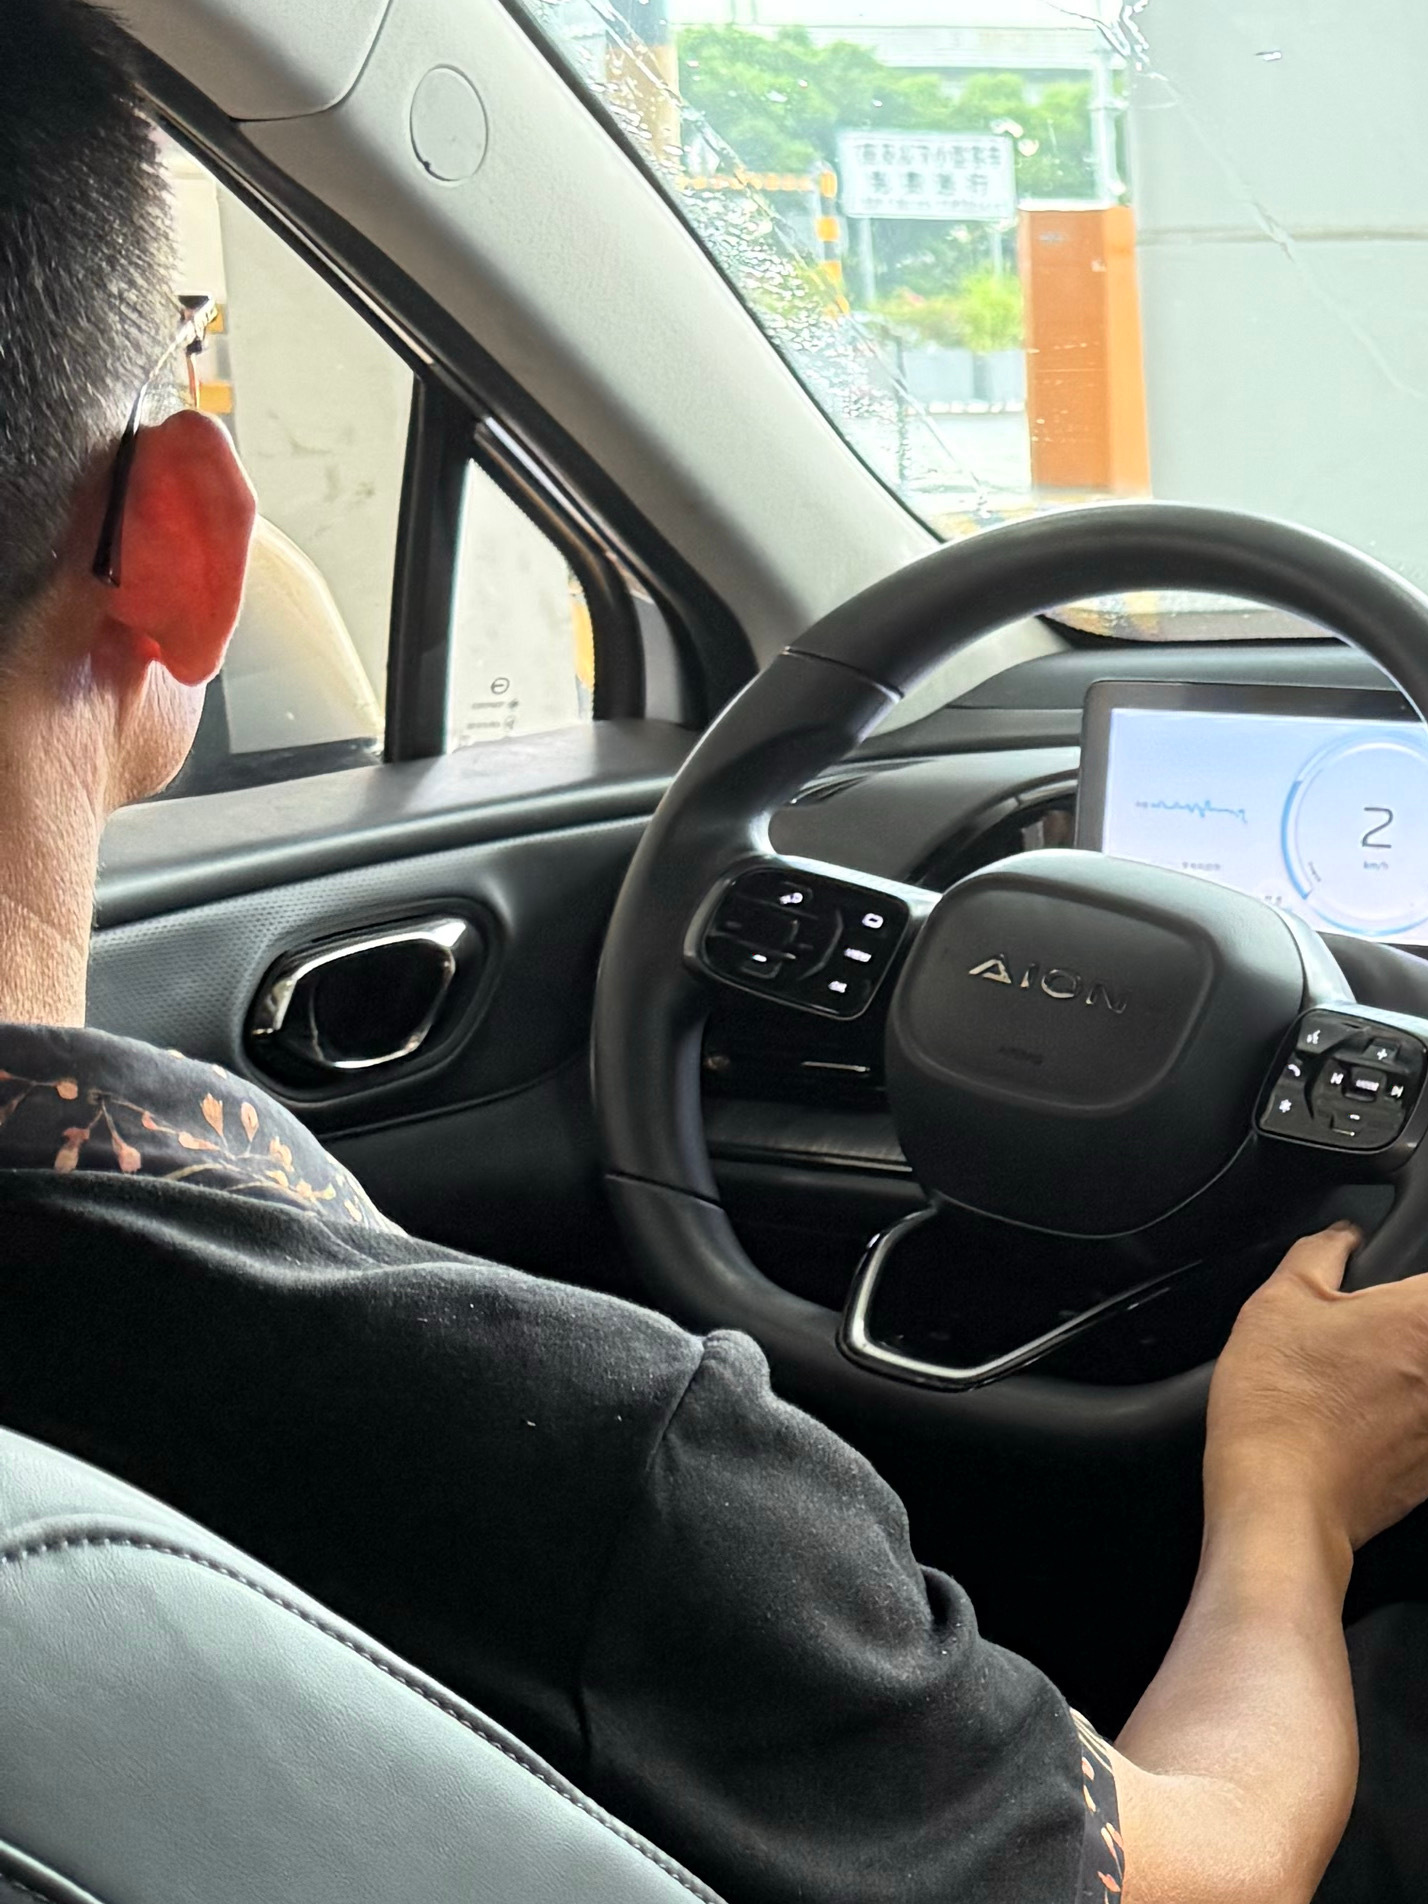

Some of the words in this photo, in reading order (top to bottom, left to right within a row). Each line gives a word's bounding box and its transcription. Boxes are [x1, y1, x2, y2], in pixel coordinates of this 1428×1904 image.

[1361, 807, 1393, 848] 2
[1363, 861, 1389, 871] km/h
[968, 953, 1129, 1015] AION
